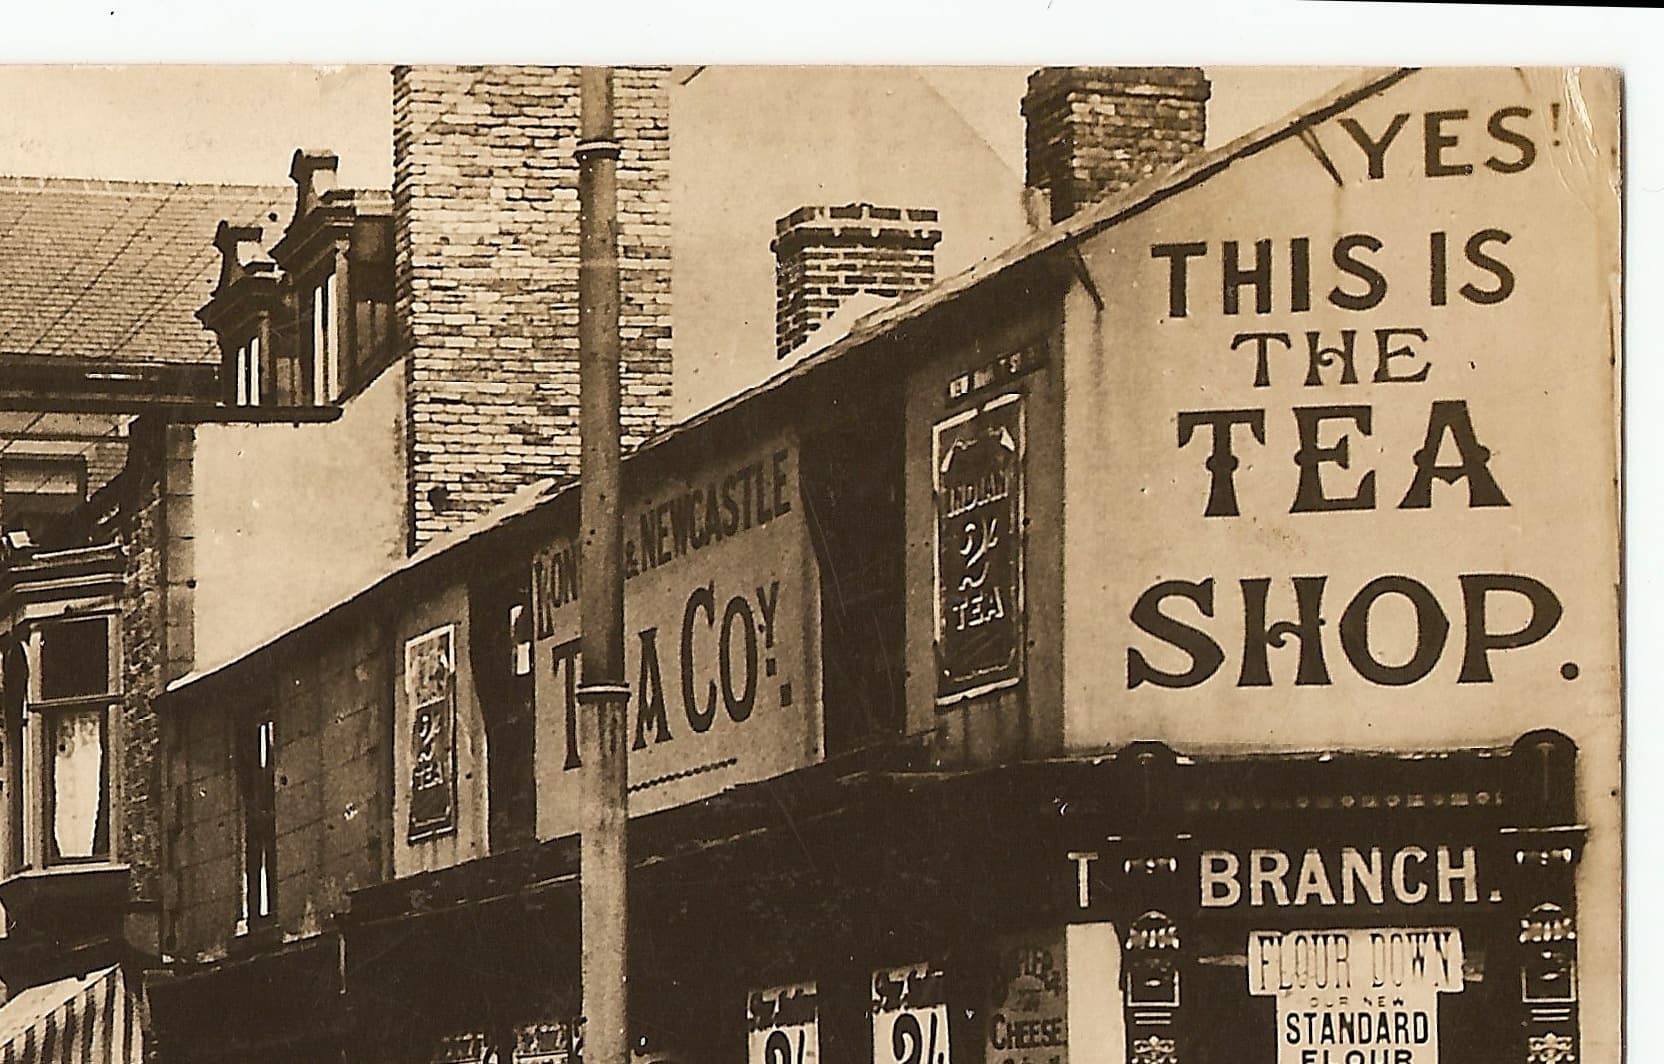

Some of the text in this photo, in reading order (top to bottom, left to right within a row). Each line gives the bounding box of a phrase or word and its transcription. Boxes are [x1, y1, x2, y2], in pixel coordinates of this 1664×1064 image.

[1339, 104, 1564, 181] YES!
[1150, 227, 1517, 319] THIS IS
[1230, 327, 1433, 388] THE
[1176, 399, 1513, 518] TEA
[639, 449, 792, 575] NEWCASTLE
[1126, 573, 1581, 690] SHOP.
[551, 627, 674, 772] TA
[1199, 846, 1503, 907] BRANCH.
[1257, 932, 1452, 990] FLOUR DOWN
[991, 1014, 1069, 1050] CHEESE
[1286, 1011, 1429, 1045] STANDARD
